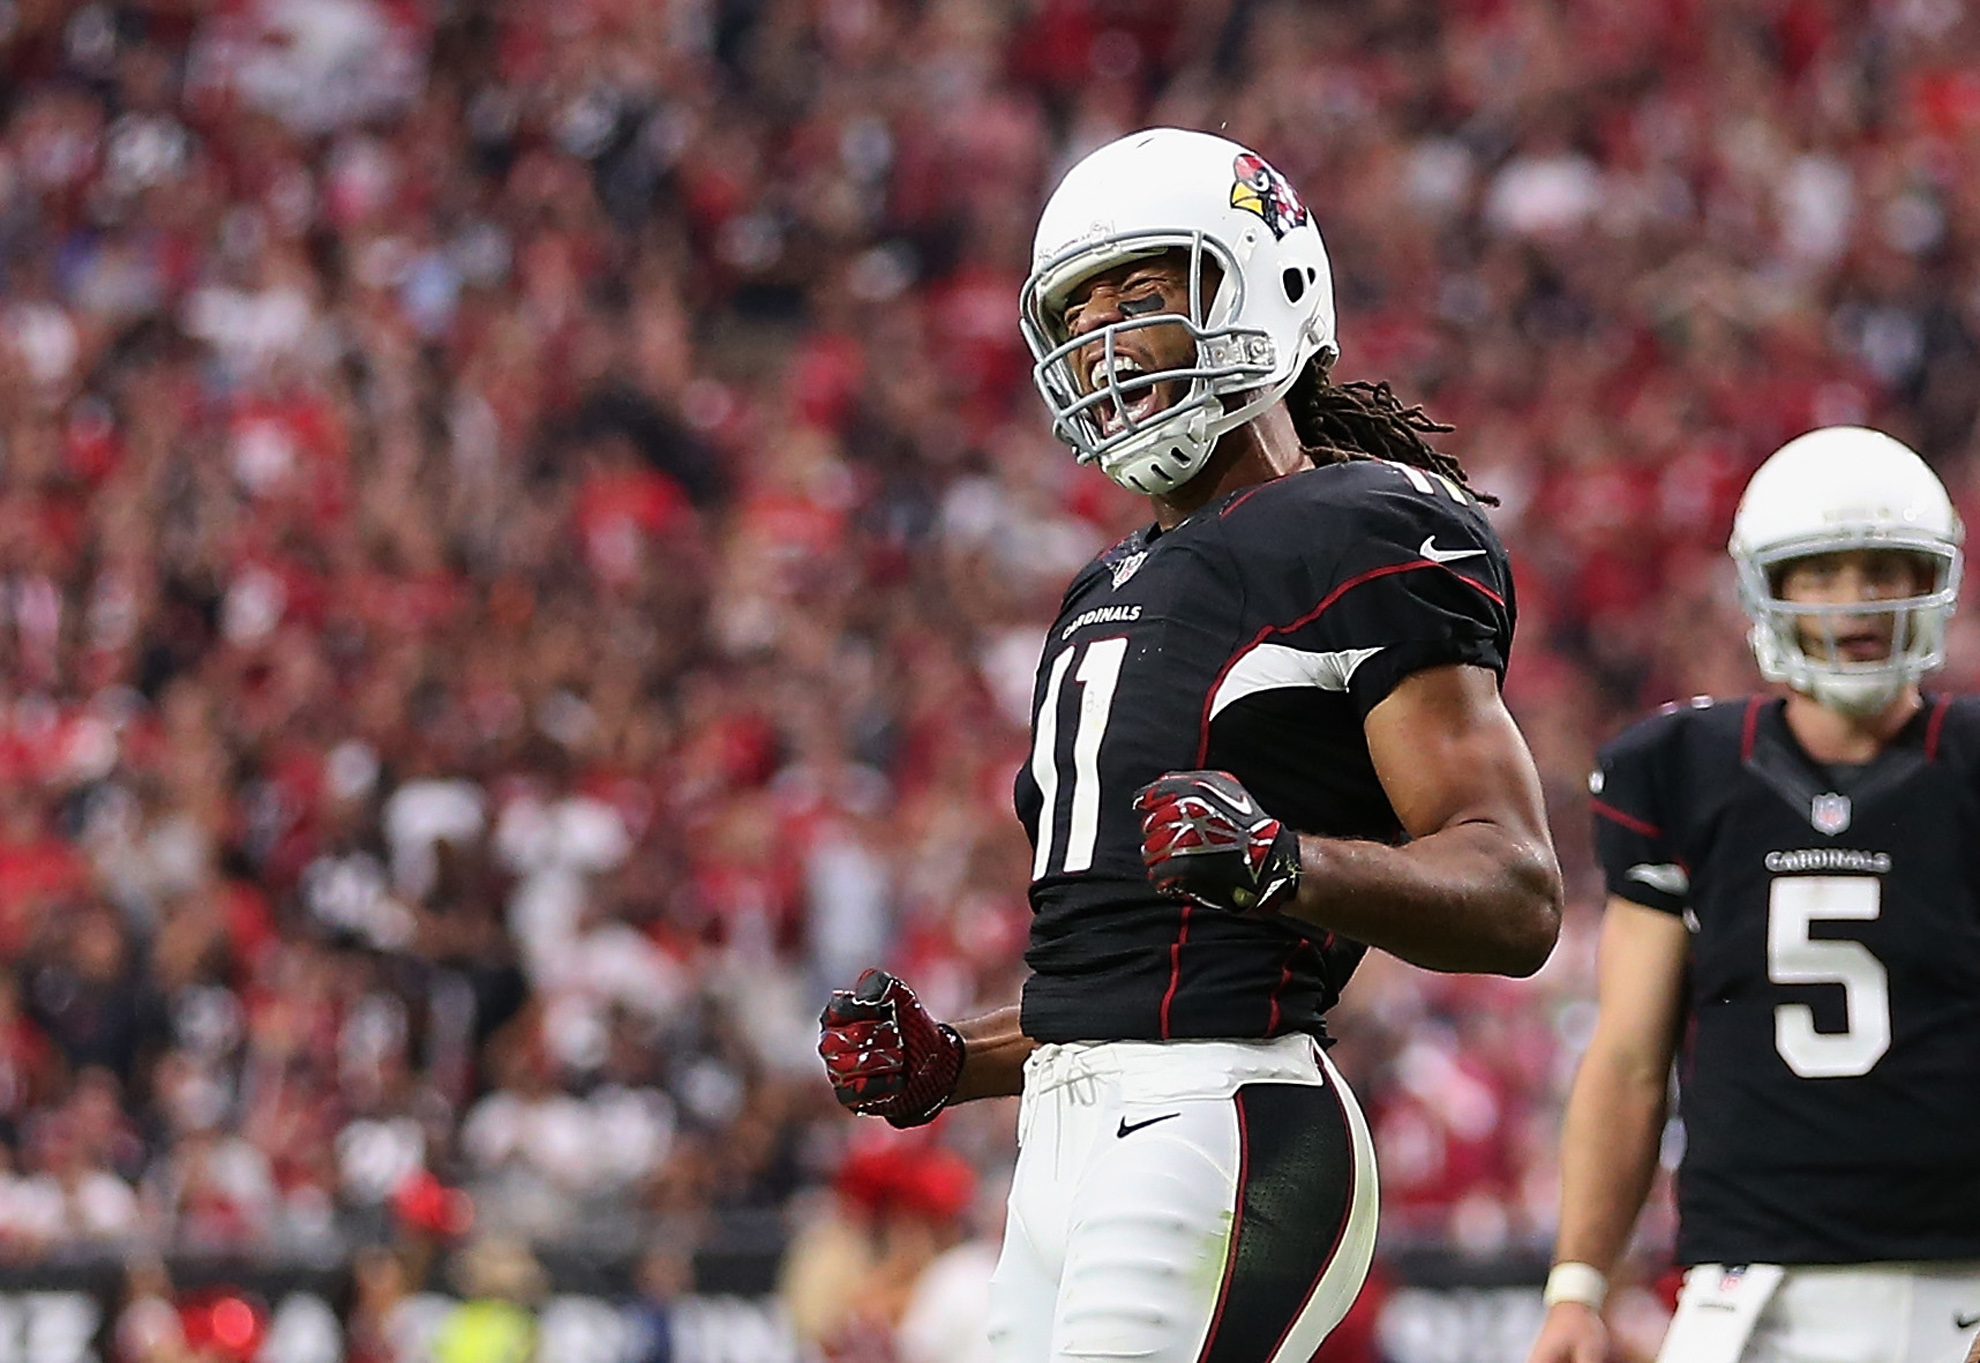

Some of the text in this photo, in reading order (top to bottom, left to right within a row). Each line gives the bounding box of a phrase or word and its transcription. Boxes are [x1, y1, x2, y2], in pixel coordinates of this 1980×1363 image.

[1032, 637, 1128, 882] 11
[1764, 848, 1892, 874] CARDINALS
[1767, 875, 1893, 1077] 5
